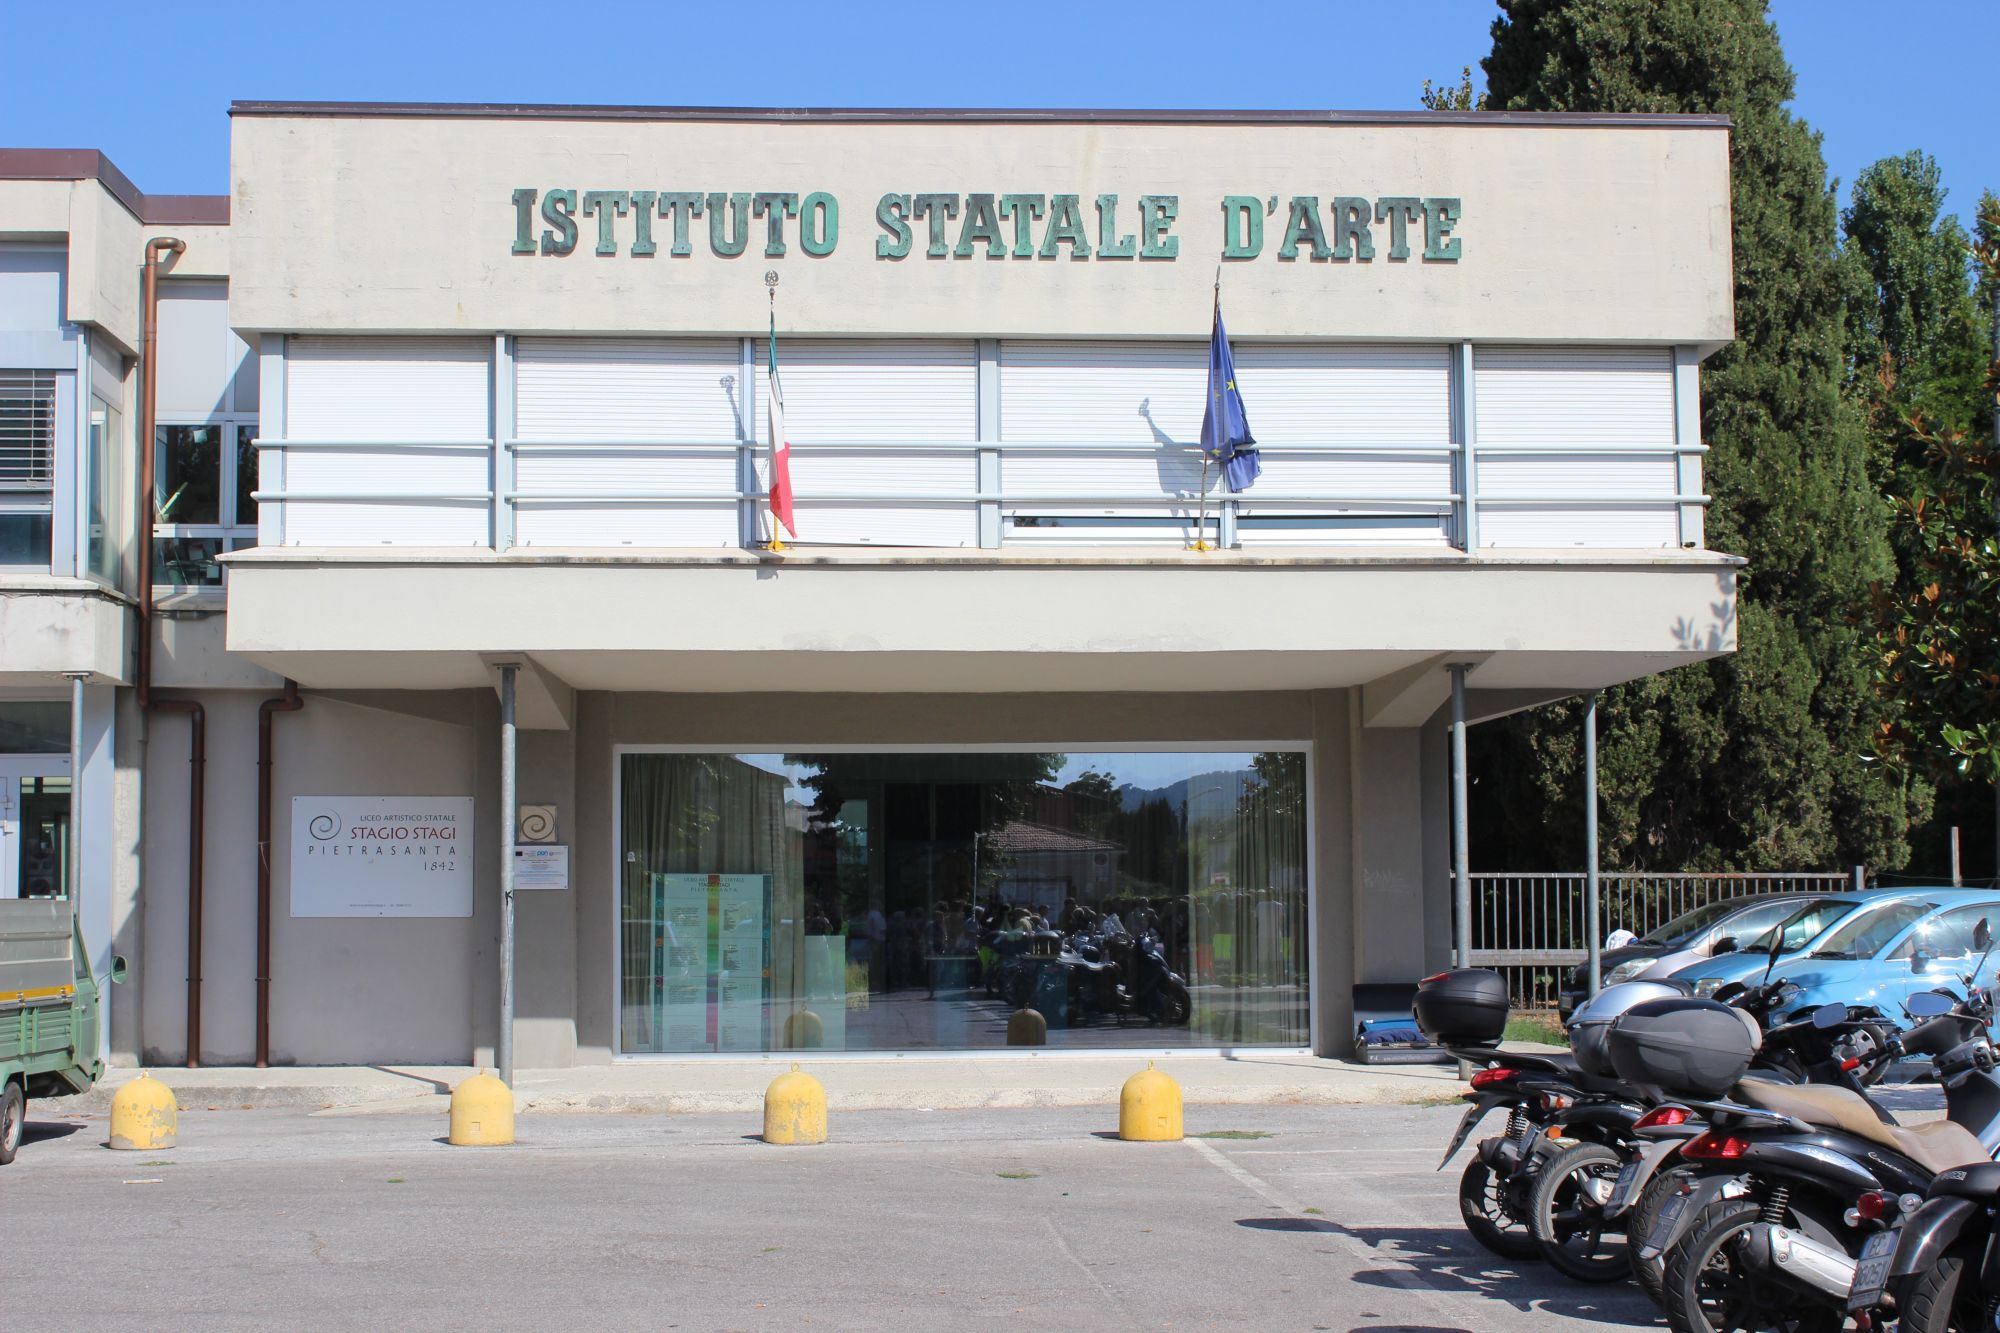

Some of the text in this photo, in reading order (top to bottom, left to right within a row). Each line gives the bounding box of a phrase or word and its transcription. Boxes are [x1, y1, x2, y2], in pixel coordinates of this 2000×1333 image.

[512, 188, 1462, 262] ISTITUTO STATALE D'ARTE
[360, 814, 456, 822] LICEO ARTISTICO STATALE
[350, 826, 456, 840] STAGIO STAGI
[308, 845, 456, 855] PIETRASANTA
[424, 861, 455, 871] 1842
